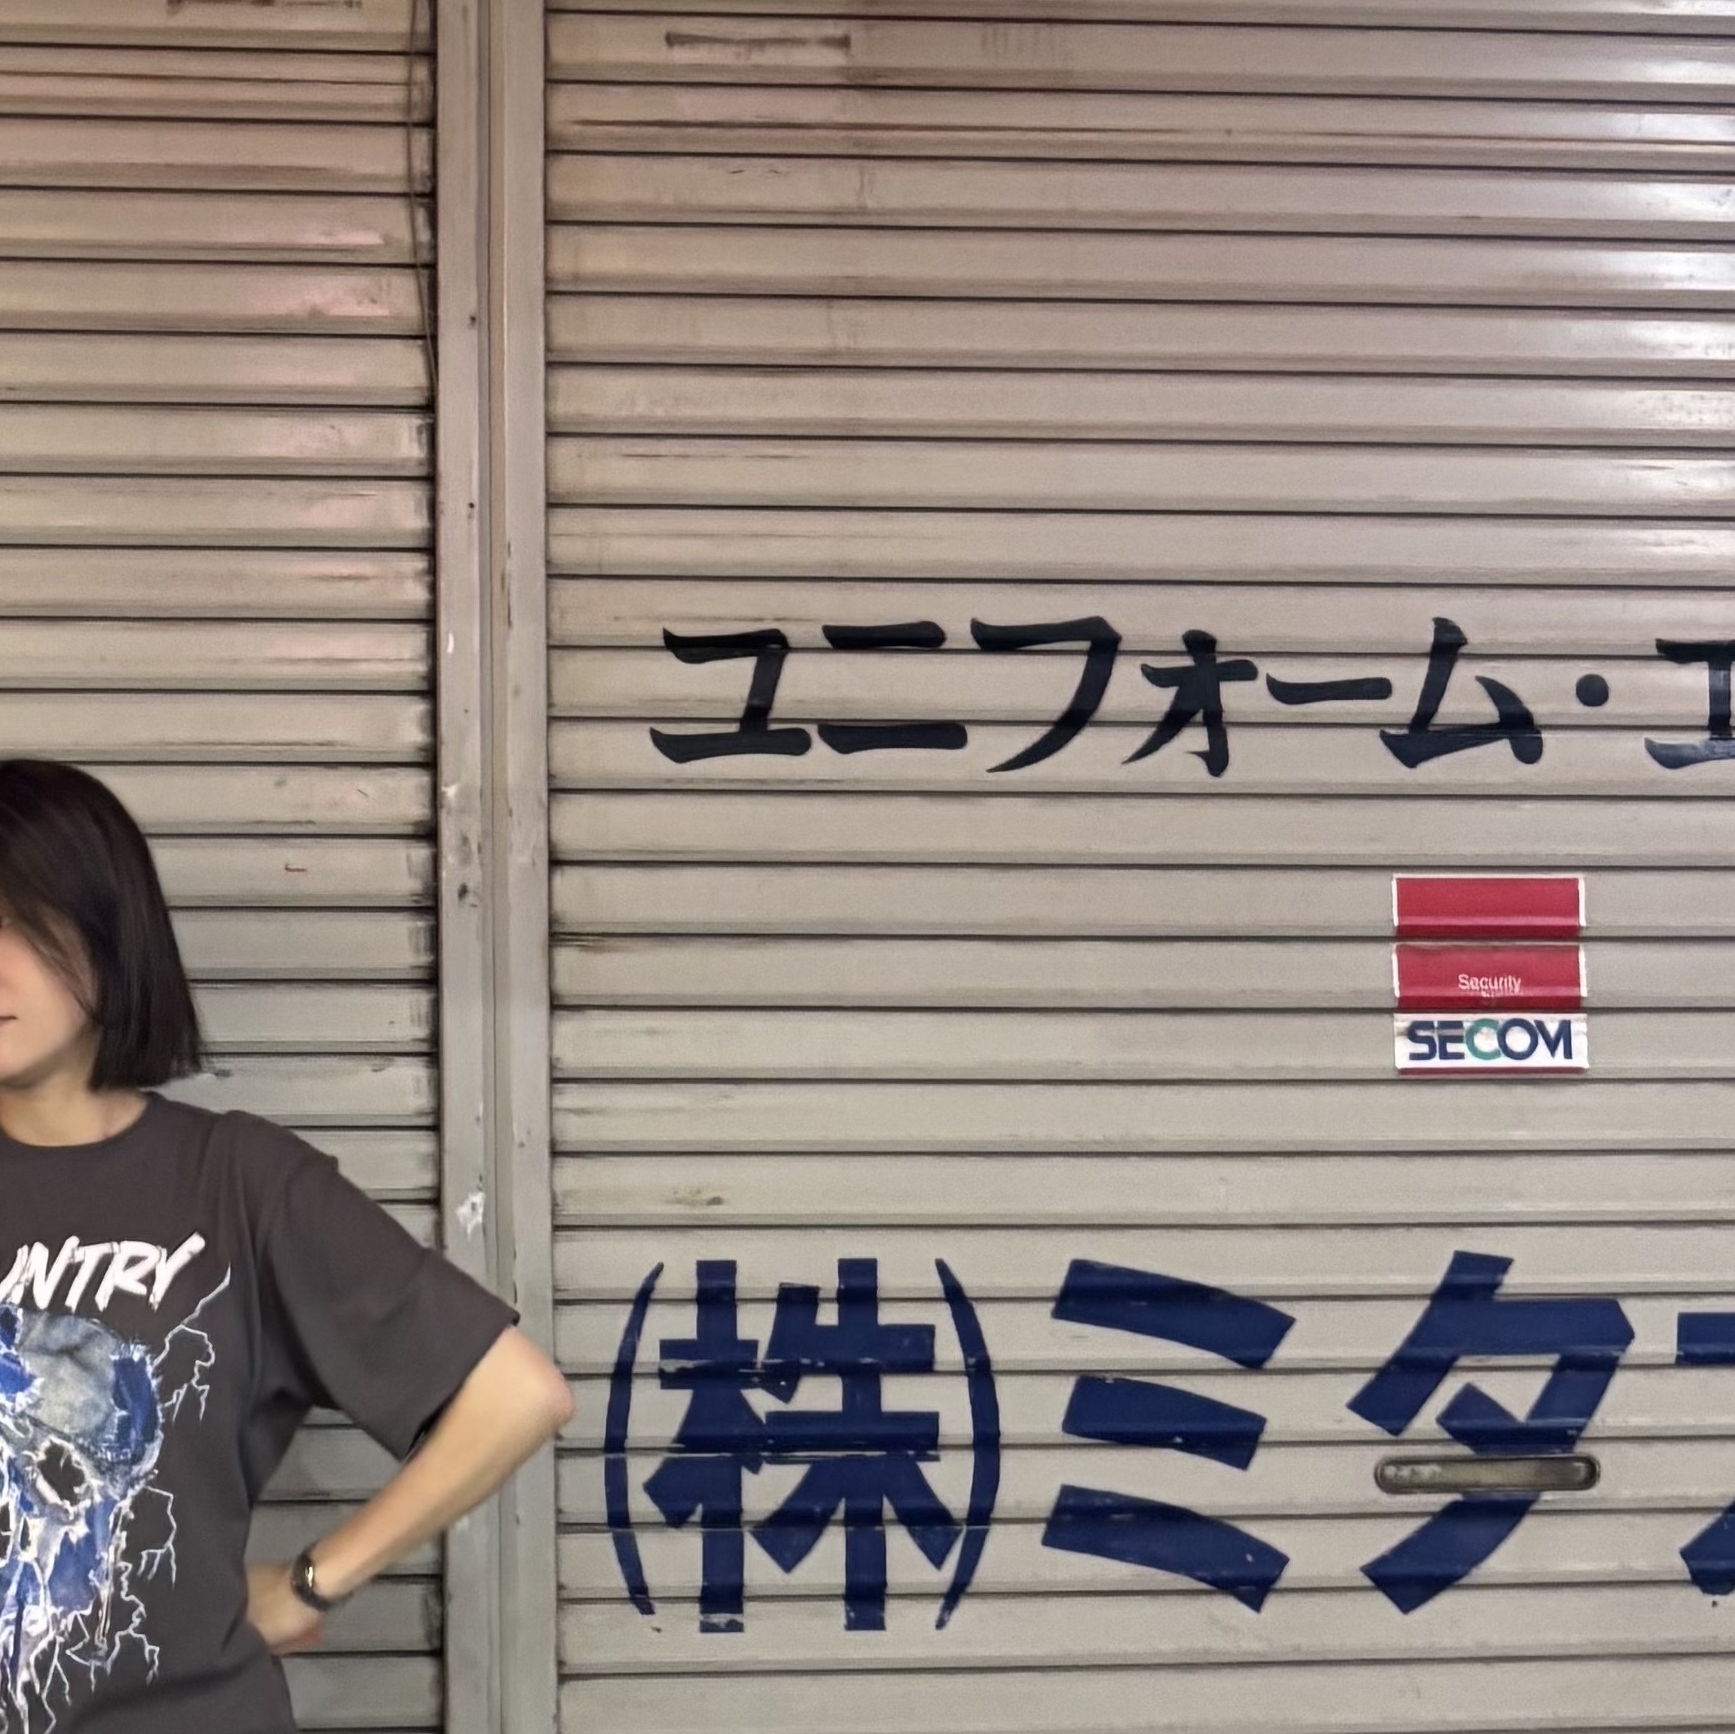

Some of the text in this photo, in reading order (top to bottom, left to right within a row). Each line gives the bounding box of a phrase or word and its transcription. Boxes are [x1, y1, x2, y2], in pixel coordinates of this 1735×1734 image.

[1458, 973, 1521, 992] Security
[1407, 1018, 1573, 1061] SECOM
[603, 1250, 1735, 1633] (株)ミタ
